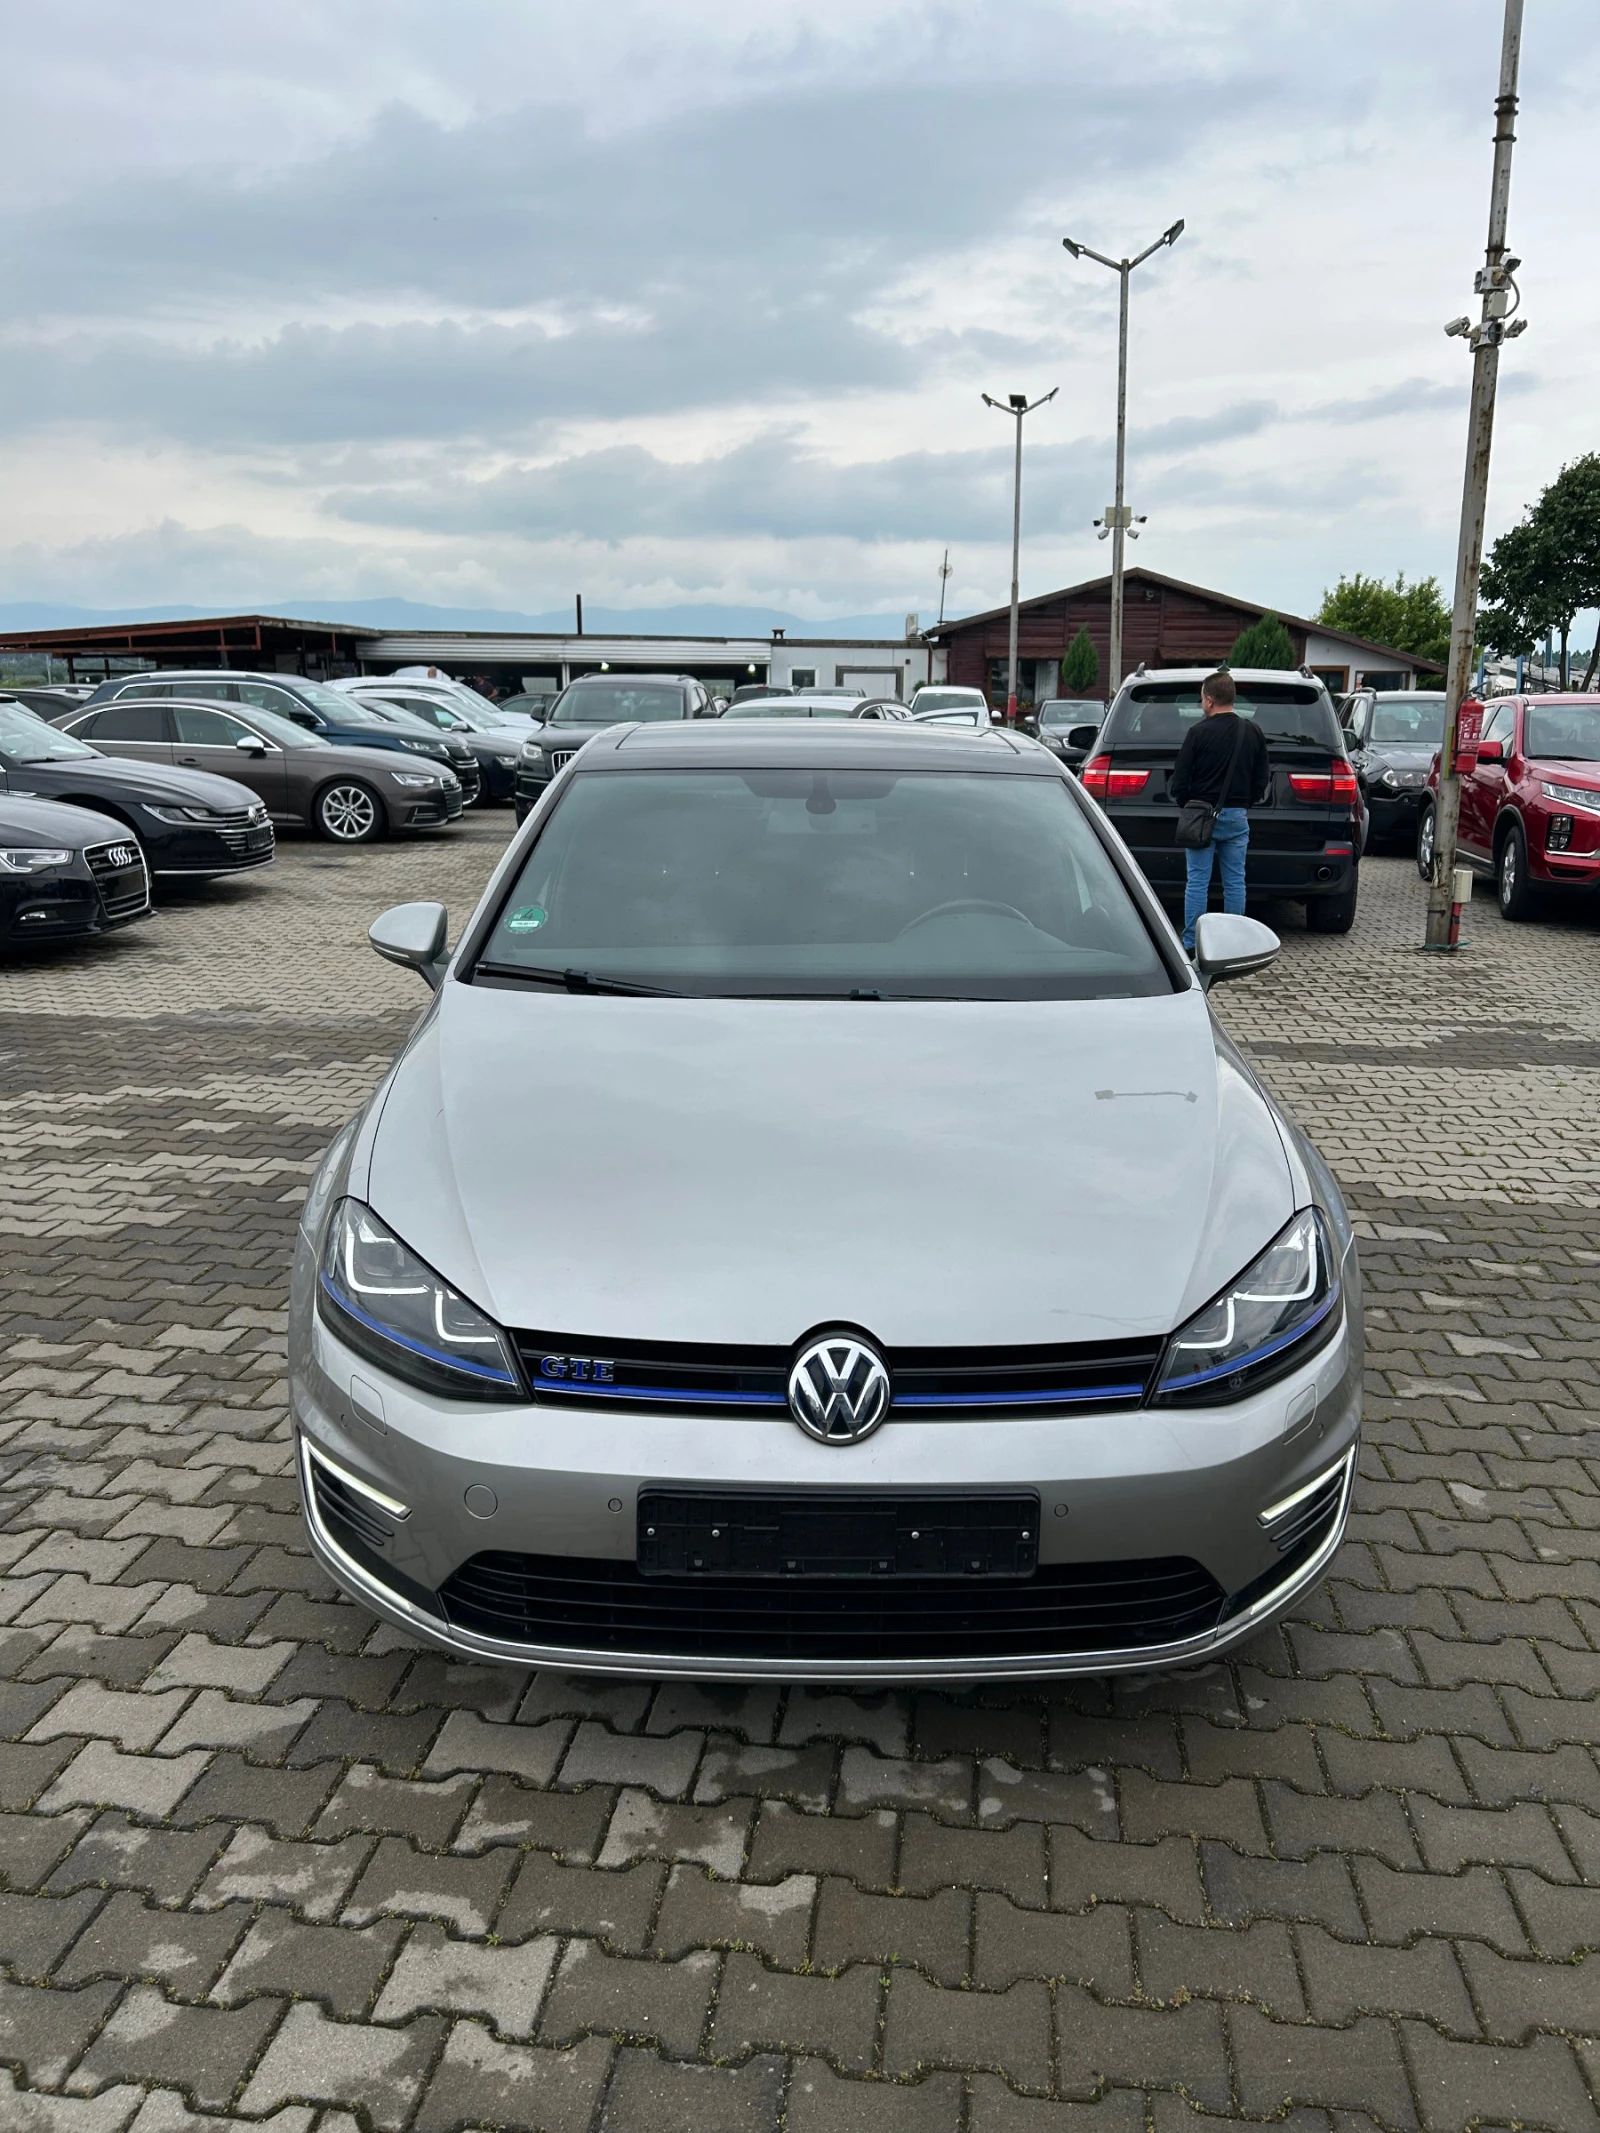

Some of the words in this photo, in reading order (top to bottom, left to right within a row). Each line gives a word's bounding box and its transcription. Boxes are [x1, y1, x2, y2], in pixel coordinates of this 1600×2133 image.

[522, 908, 535, 920] 4
[540, 1355, 615, 1382] GTE
[789, 1336, 890, 1443] VW
